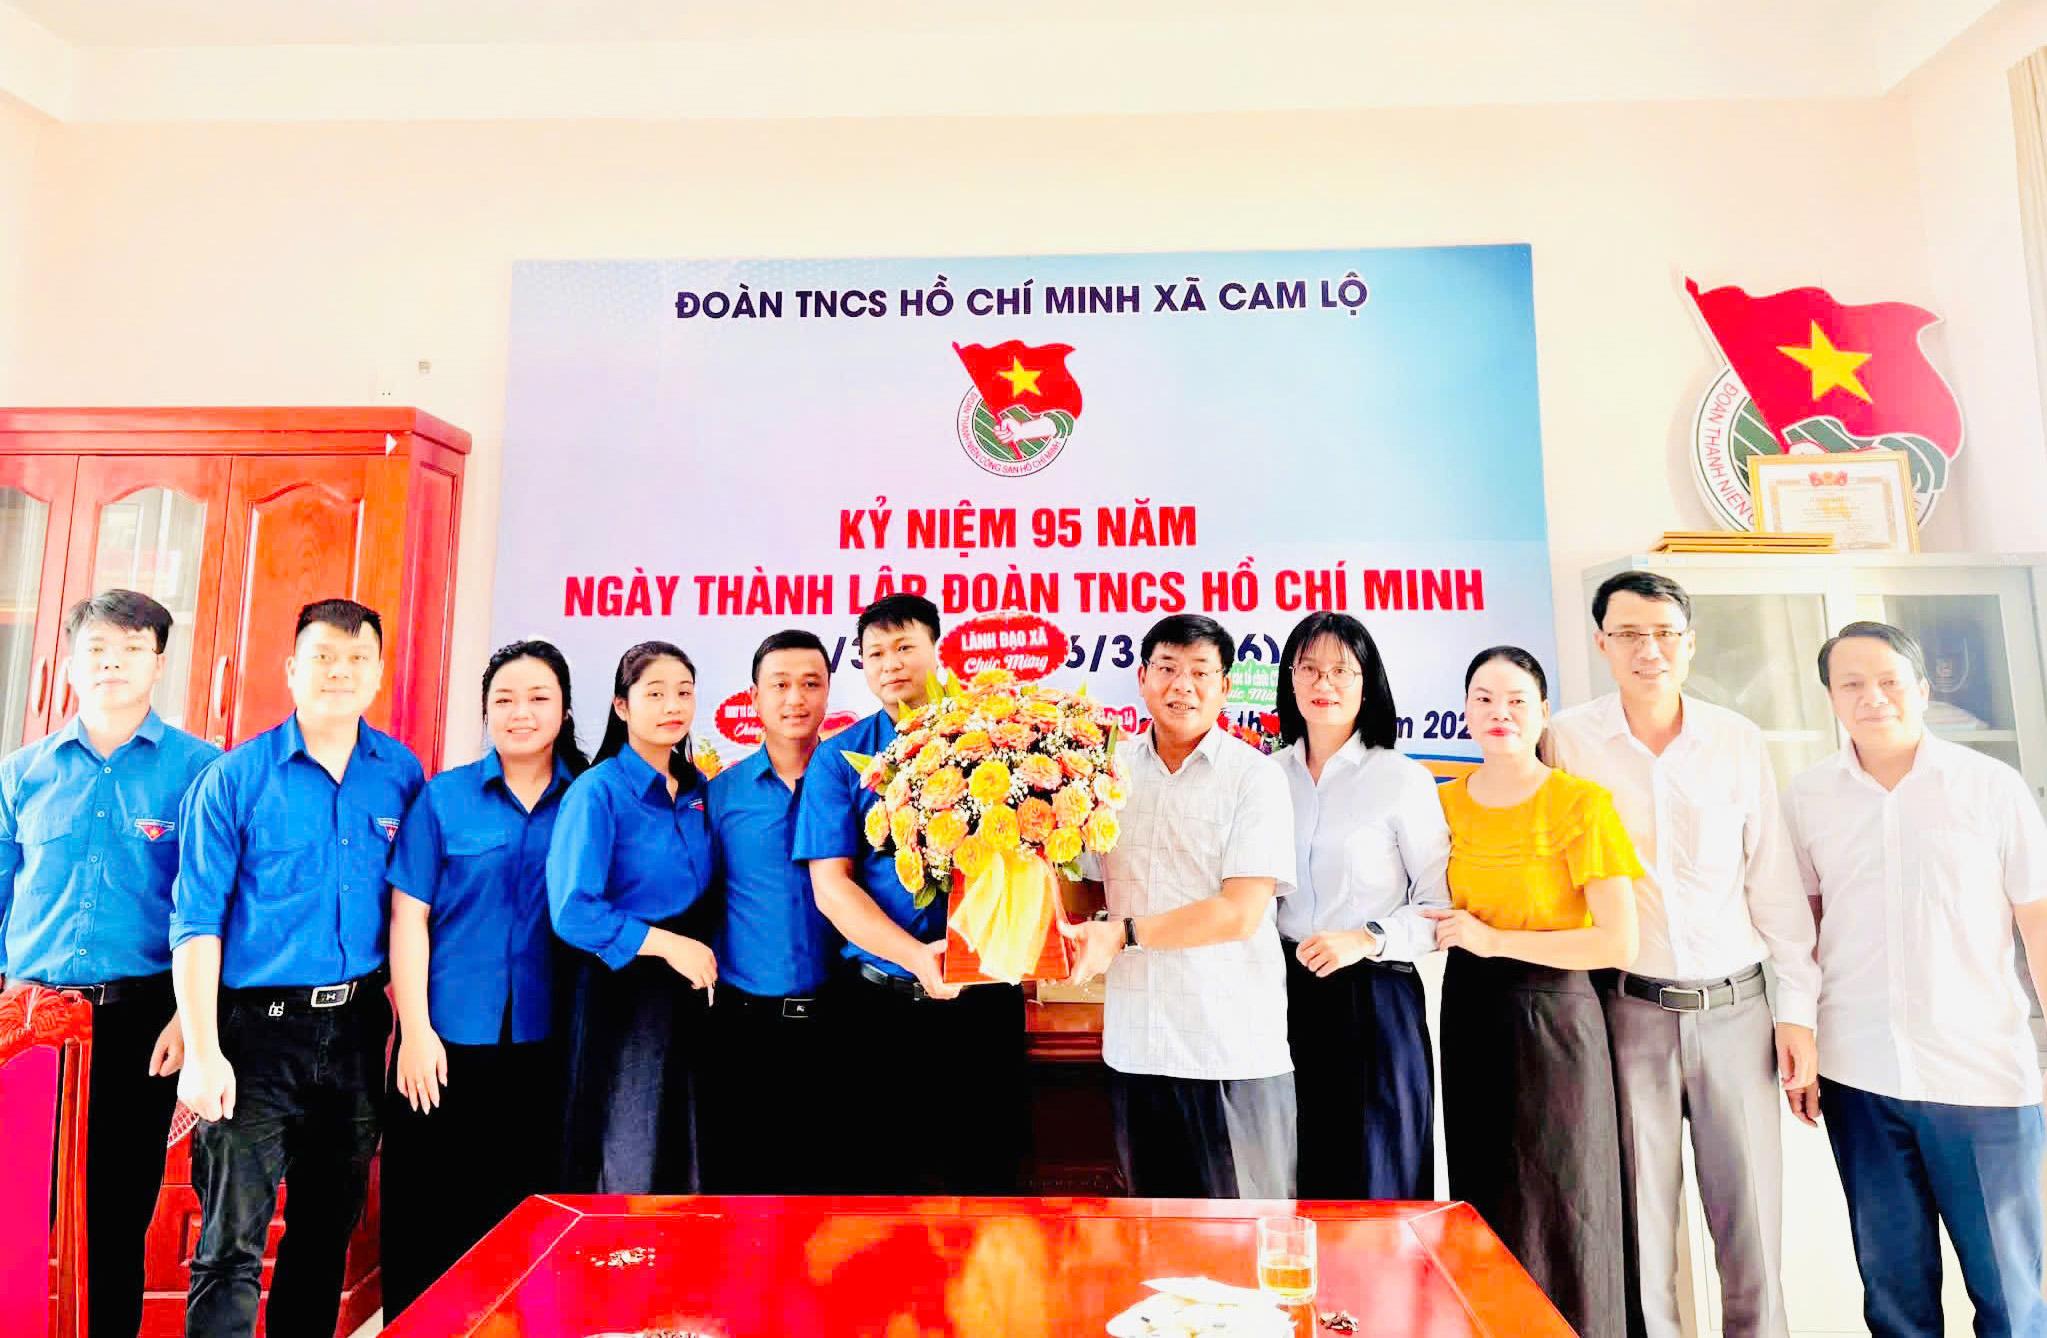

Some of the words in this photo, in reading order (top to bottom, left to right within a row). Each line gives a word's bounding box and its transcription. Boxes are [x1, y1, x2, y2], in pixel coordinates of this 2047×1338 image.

[675, 283, 782, 318] ĐOÀN
[796, 290, 886, 317] TNCS
[900, 274, 954, 316] HỒ
[966, 278, 1033, 315] CHÍ
[1045, 285, 1140, 314] MINH
[1154, 277, 1206, 312] XÃ
[1218, 281, 1305, 310] CAM
[1321, 272, 1368, 315] LỘ
[1704, 429, 1726, 479] THANH
[839, 496, 892, 549] KỶ
[907, 499, 1017, 558] NIỆM
[1032, 508, 1082, 548] 95
[1098, 498, 1196, 547] NĂM
[564, 567, 680, 617] NGÀY
[693, 566, 834, 616] THÀNH
[941, 564, 1060, 614] ĐOÀN
[1073, 571, 1187, 613] TNCS
[1201, 556, 1259, 612] HỒ
[1275, 561, 1348, 612] CHÍ
[1364, 569, 1485, 611] MINH
[1424, 710, 1473, 740] 202
